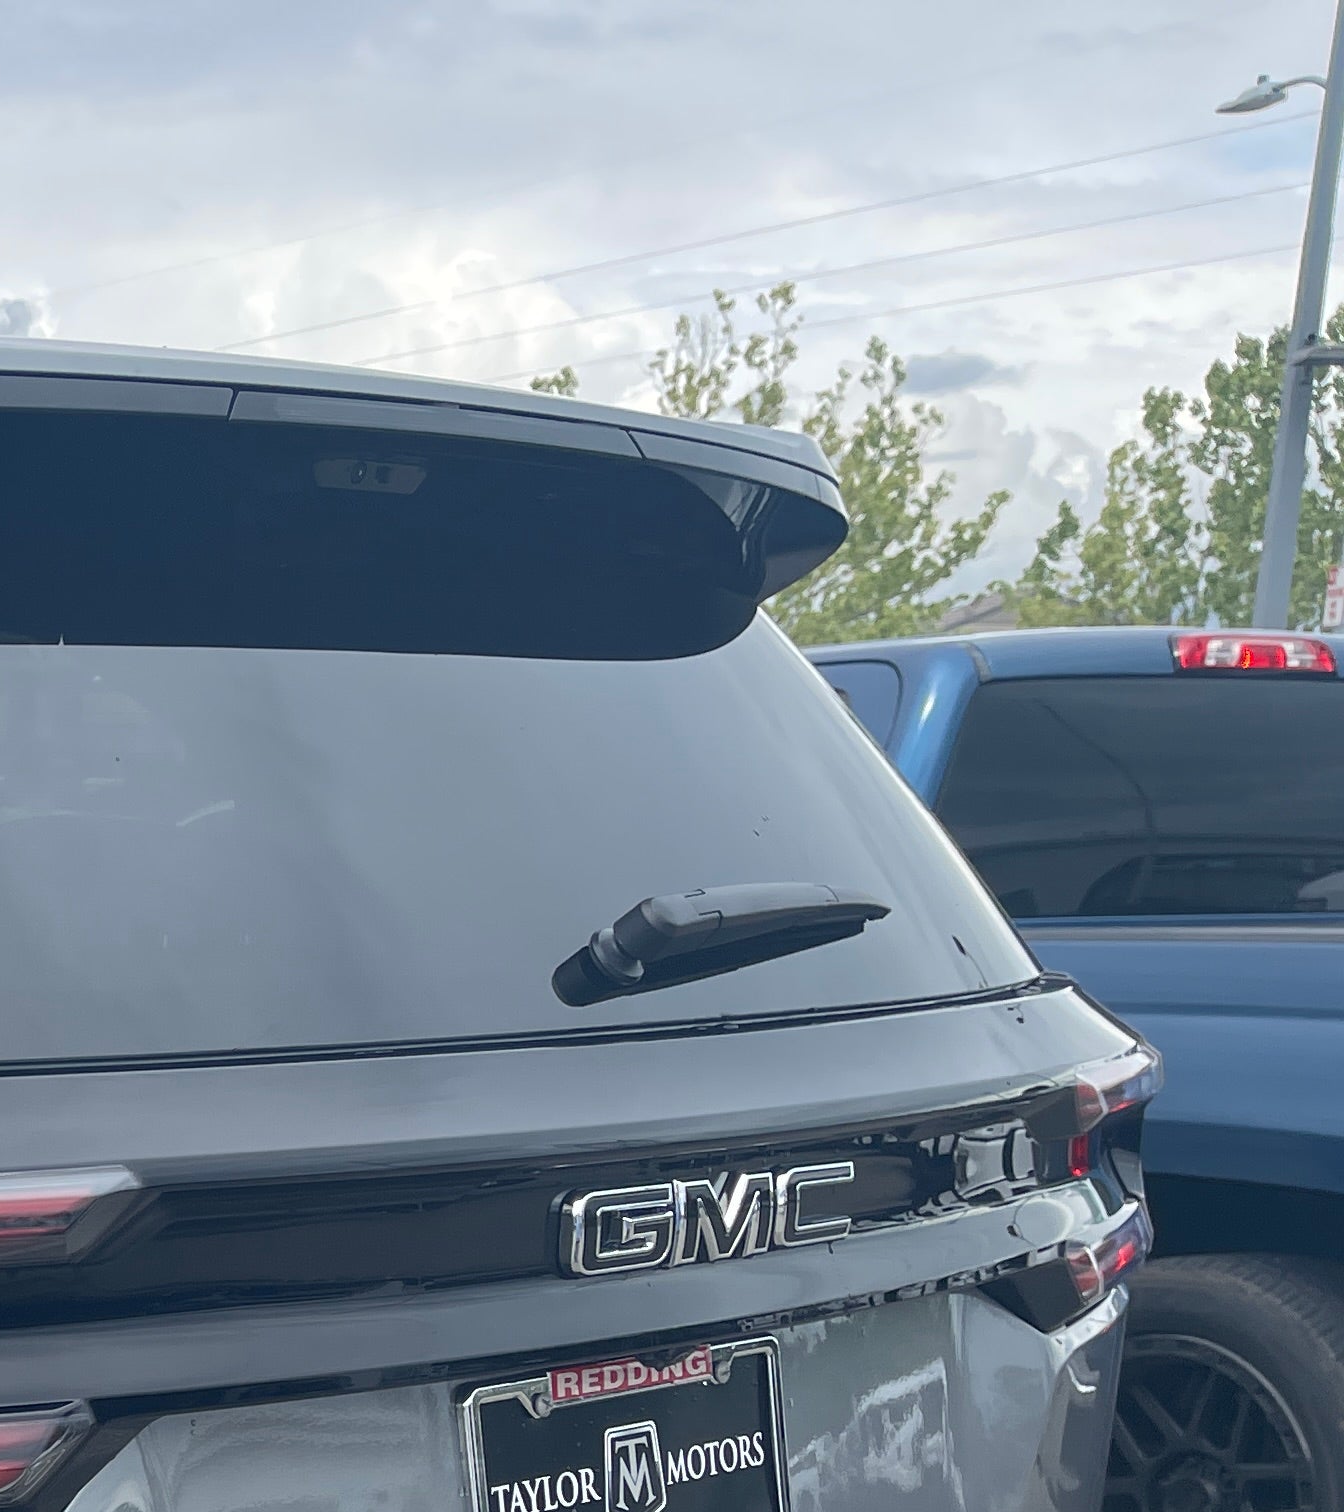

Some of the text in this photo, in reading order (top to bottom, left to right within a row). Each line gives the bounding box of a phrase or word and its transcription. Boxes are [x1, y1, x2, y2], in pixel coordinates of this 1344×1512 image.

[569, 1161, 855, 1276] GMC
[556, 1352, 708, 1399] REDDING
[666, 1431, 765, 1486] MOTORS
